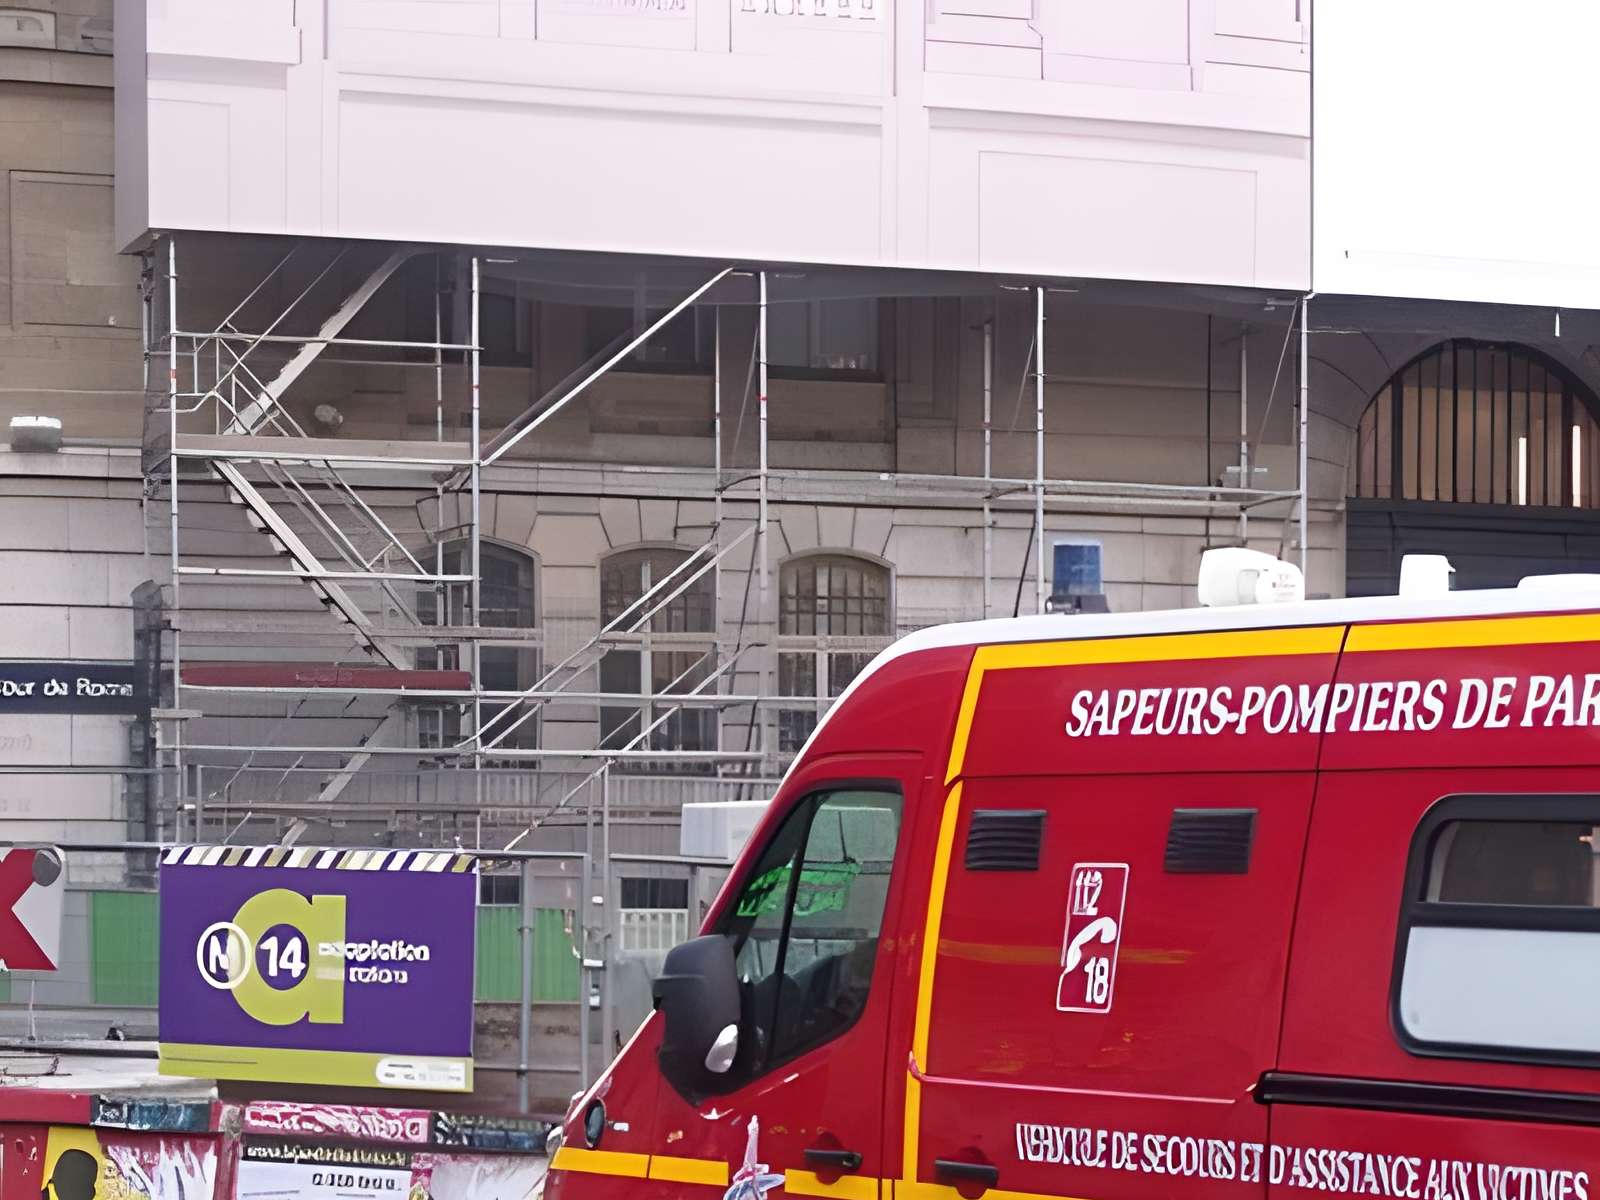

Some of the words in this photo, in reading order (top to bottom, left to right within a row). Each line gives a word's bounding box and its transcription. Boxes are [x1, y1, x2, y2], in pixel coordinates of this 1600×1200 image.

[1065, 679, 1448, 737] SAPEURS-POMPIERS
[1452, 677, 1518, 730] DE
[259, 936, 306, 978] 14
[1084, 956, 1109, 1004] 18
[1112, 1131, 1138, 1172] DE
[1140, 1134, 1235, 1180] SECOURS
[1240, 1142, 1264, 1183] ET
[1268, 1144, 1421, 1199] D'ASSISTANCE
